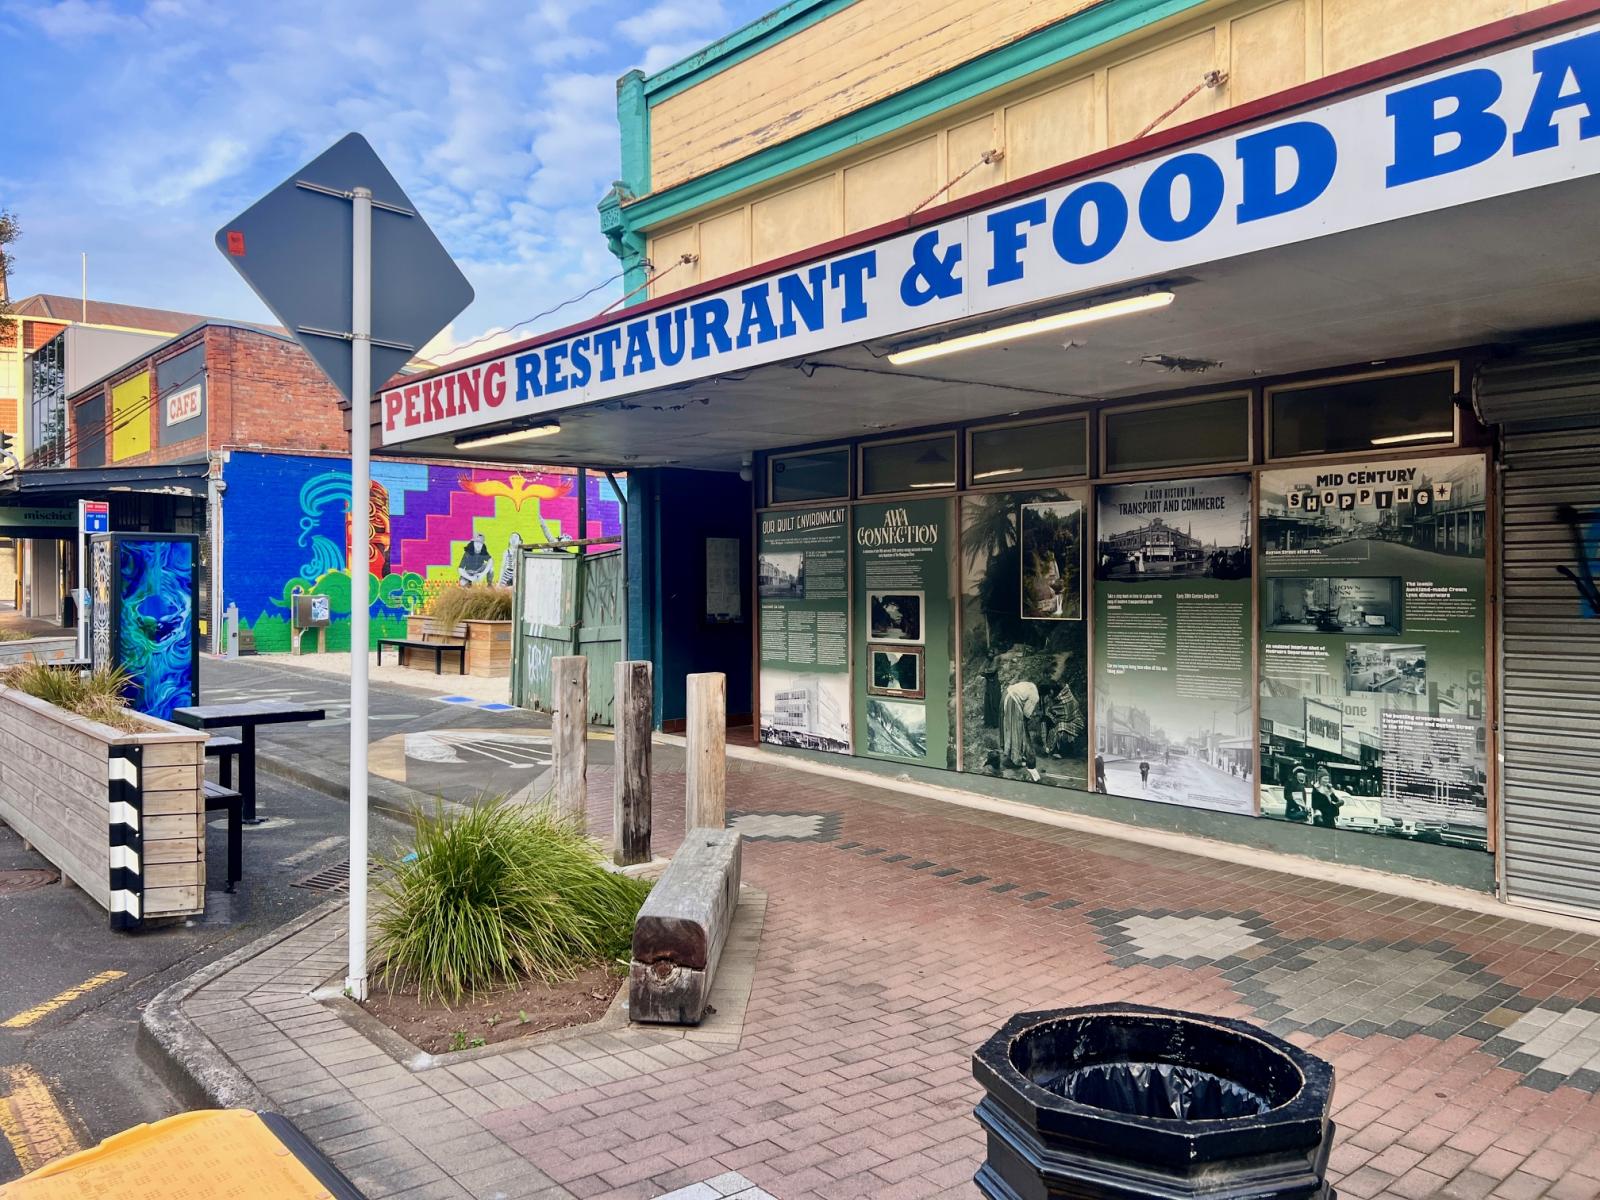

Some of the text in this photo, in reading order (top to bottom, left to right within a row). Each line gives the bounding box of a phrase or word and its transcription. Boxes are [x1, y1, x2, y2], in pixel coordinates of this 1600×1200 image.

[385, 361, 506, 431] PEKING
[515, 249, 877, 402] RESTAURANT
[900, 229, 963, 306] &
[987, 121, 1337, 287] FOOD
[170, 391, 197, 419] CAFE
[1316, 468, 1417, 487] MID CENTURY
[1164, 487, 1187, 499] HISTORY
[1289, 487, 1430, 511] SHOPPING
[1119, 496, 1225, 515] TRANSPORT AND COMMERCE
[762, 509, 845, 534] OUR BUILT ENVIRONMENT
[884, 508, 908, 527] AWA
[857, 524, 938, 547] CONNECTION
